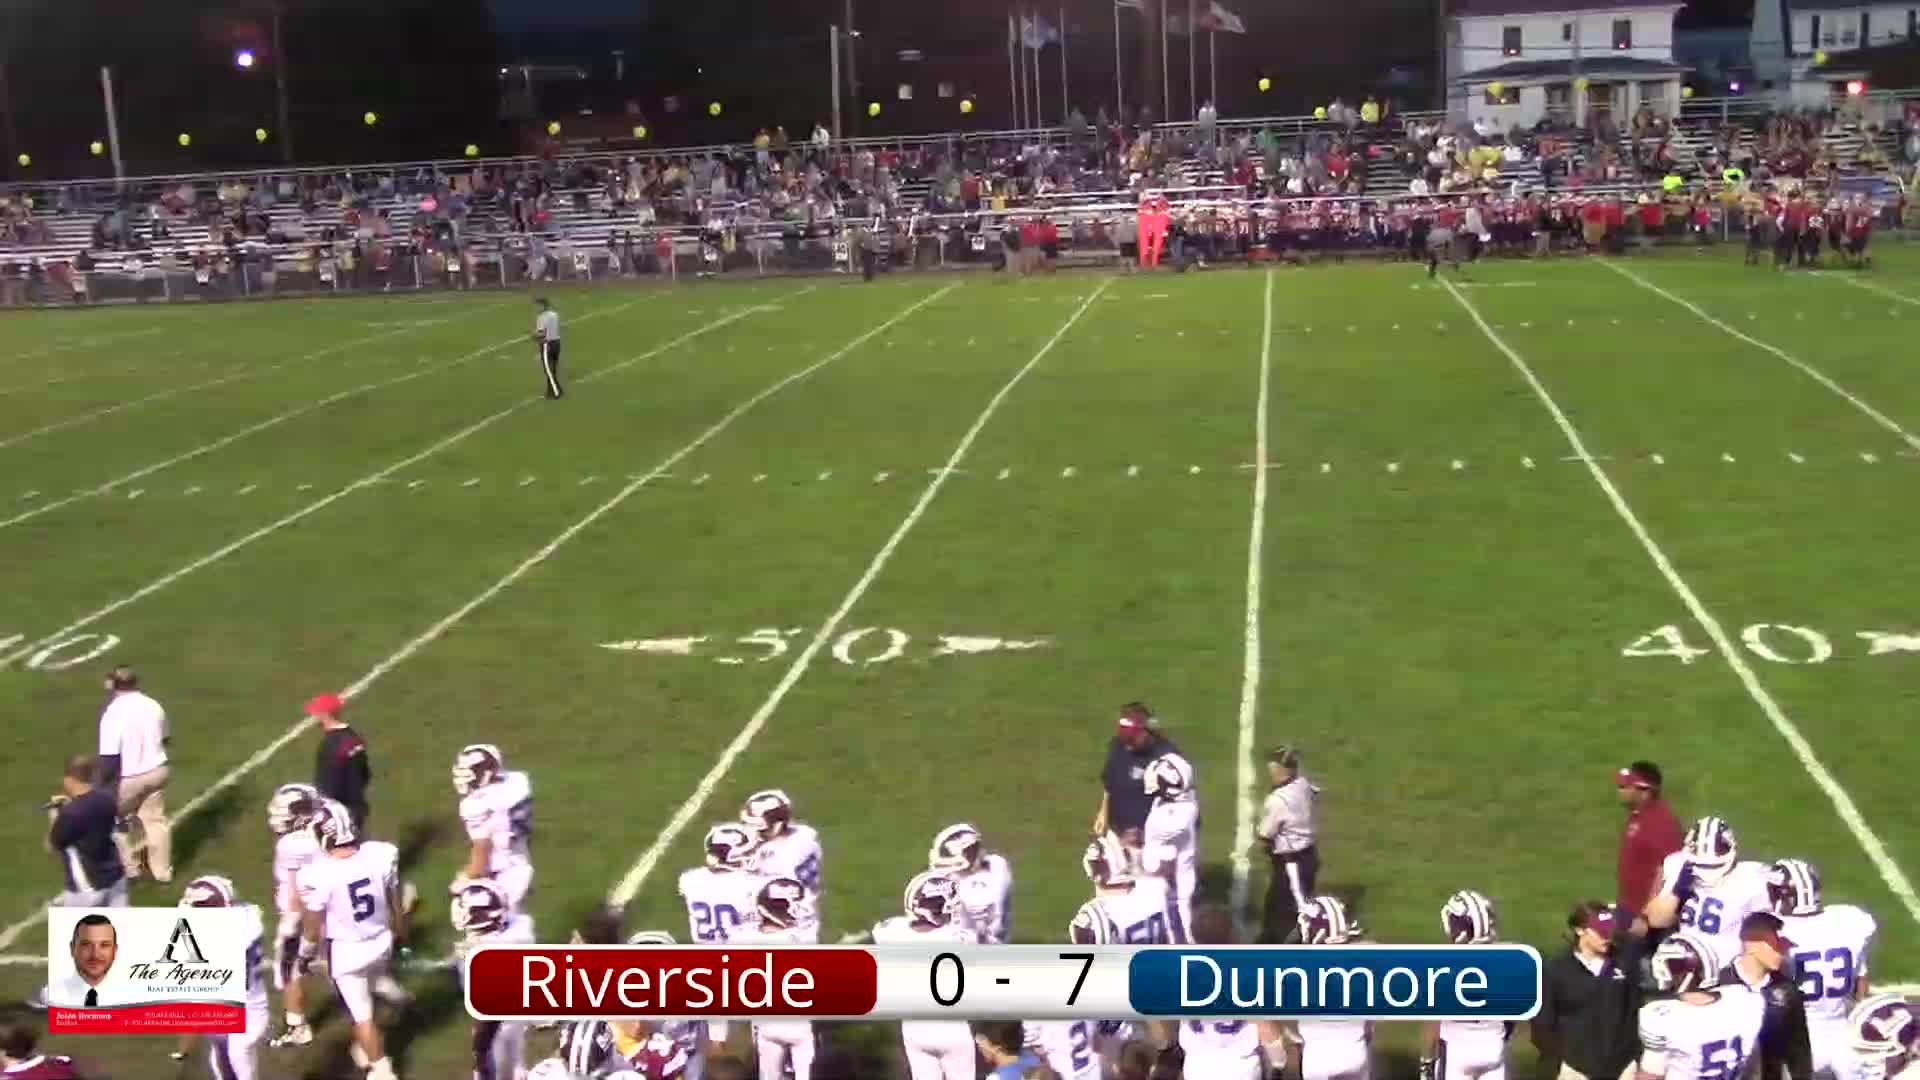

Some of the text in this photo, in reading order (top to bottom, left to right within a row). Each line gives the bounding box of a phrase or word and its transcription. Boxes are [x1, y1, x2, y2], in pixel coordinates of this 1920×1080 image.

[714, 627, 909, 665] 50
[1622, 624, 1832, 664] 40
[347, 878, 375, 922] 5
[692, 901, 740, 941] 20
[1794, 947, 1853, 1002] 53
[1699, 1036, 1745, 1080] 51
